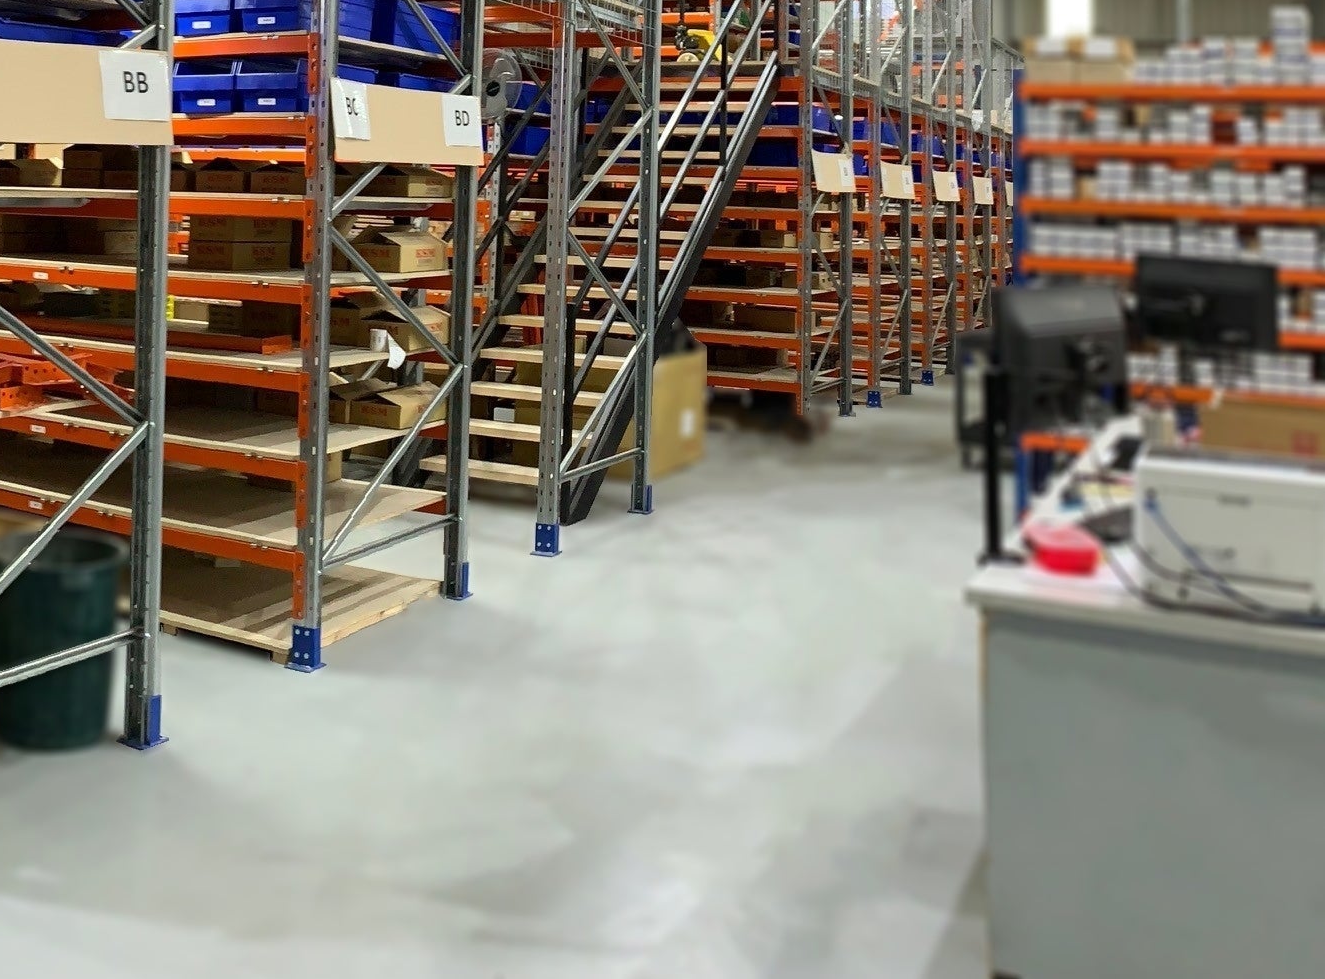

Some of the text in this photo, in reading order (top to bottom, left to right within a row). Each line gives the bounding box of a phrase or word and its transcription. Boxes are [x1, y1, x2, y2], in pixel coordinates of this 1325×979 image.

[122, 70, 149, 94] BB
[345, 96, 359, 116] BC
[454, 110, 470, 127] BD
